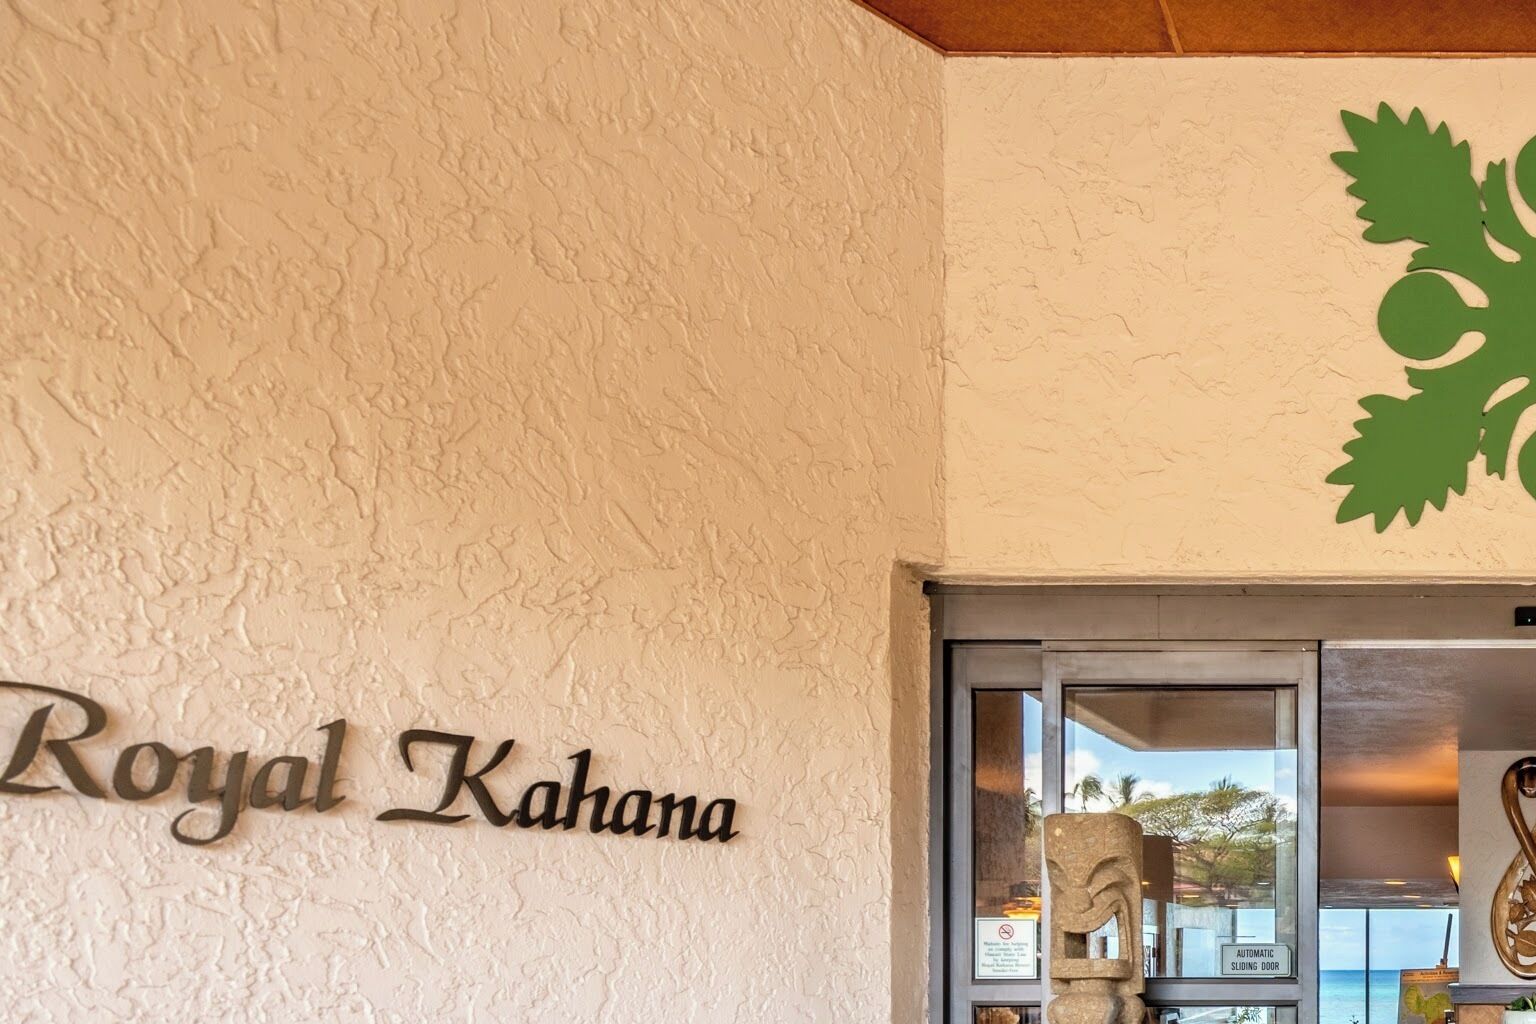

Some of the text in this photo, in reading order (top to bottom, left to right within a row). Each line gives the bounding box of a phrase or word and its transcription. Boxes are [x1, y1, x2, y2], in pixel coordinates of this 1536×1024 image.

[0, 680, 741, 847] Royal Kahana
[1236, 949, 1274, 958] AUTOMATIC
[1231, 962, 1280, 971] SLIDING DOOR
